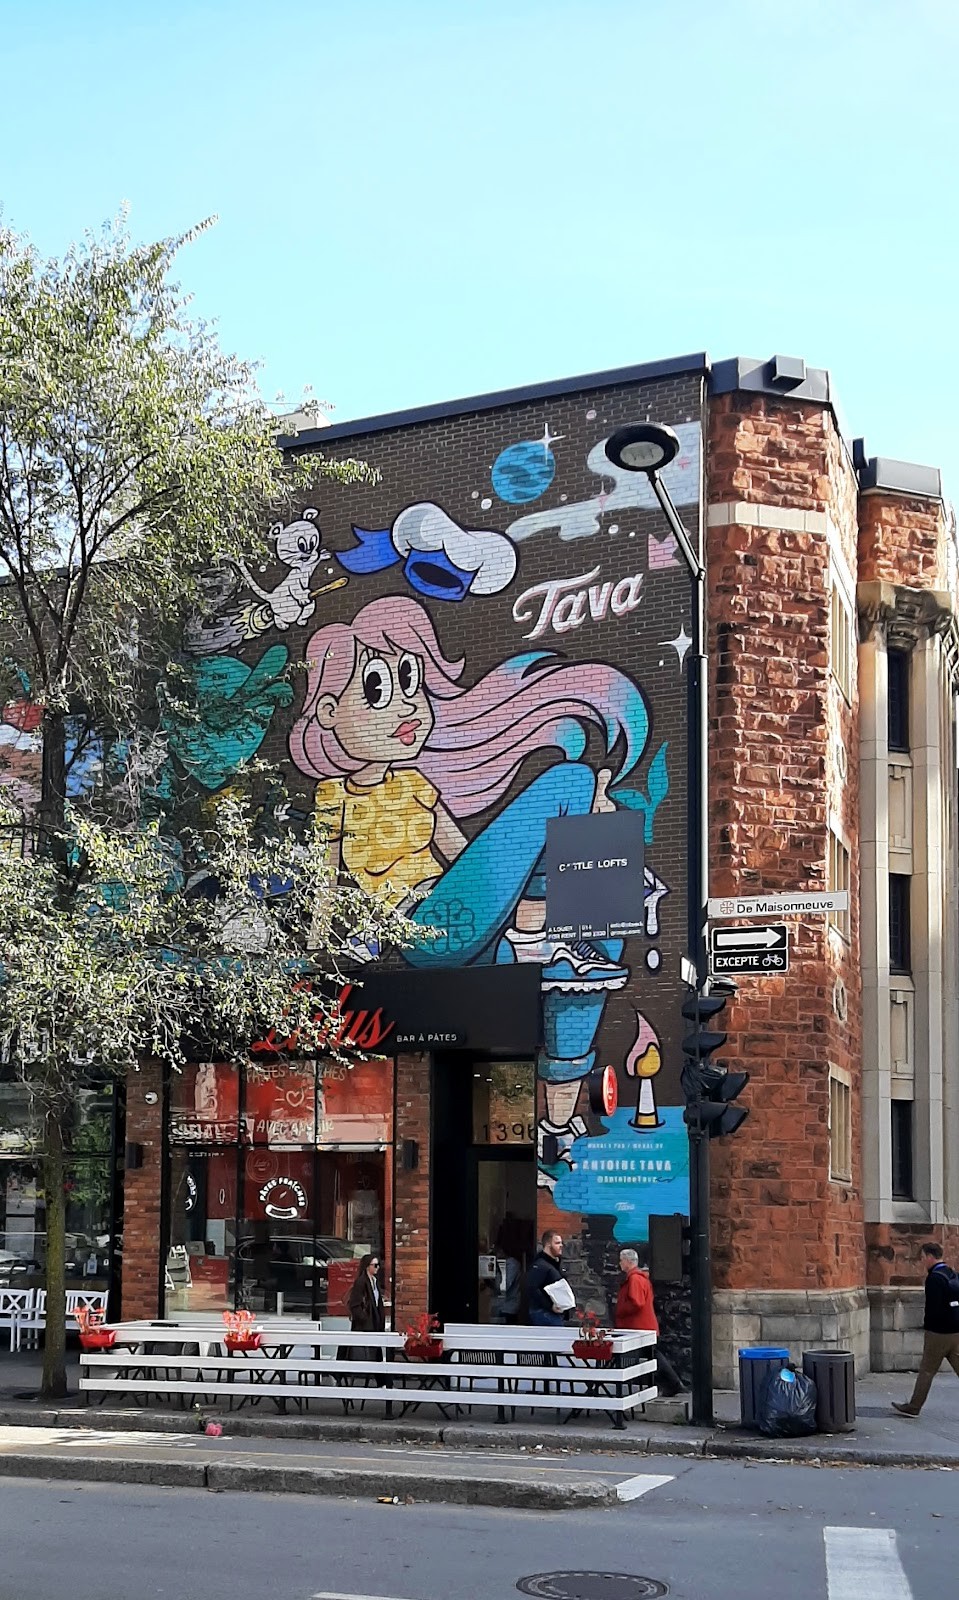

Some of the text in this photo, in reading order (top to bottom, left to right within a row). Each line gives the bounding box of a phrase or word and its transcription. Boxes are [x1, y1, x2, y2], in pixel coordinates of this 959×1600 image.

[512, 564, 644, 640] Tava
[559, 858, 628, 872] CSTLE LOFTS
[737, 904, 753, 913] De
[756, 900, 834, 912] Maisonneuve
[397, 1034, 415, 1042] BAR
[582, 1160, 672, 1171] ANTOINE TAVA
